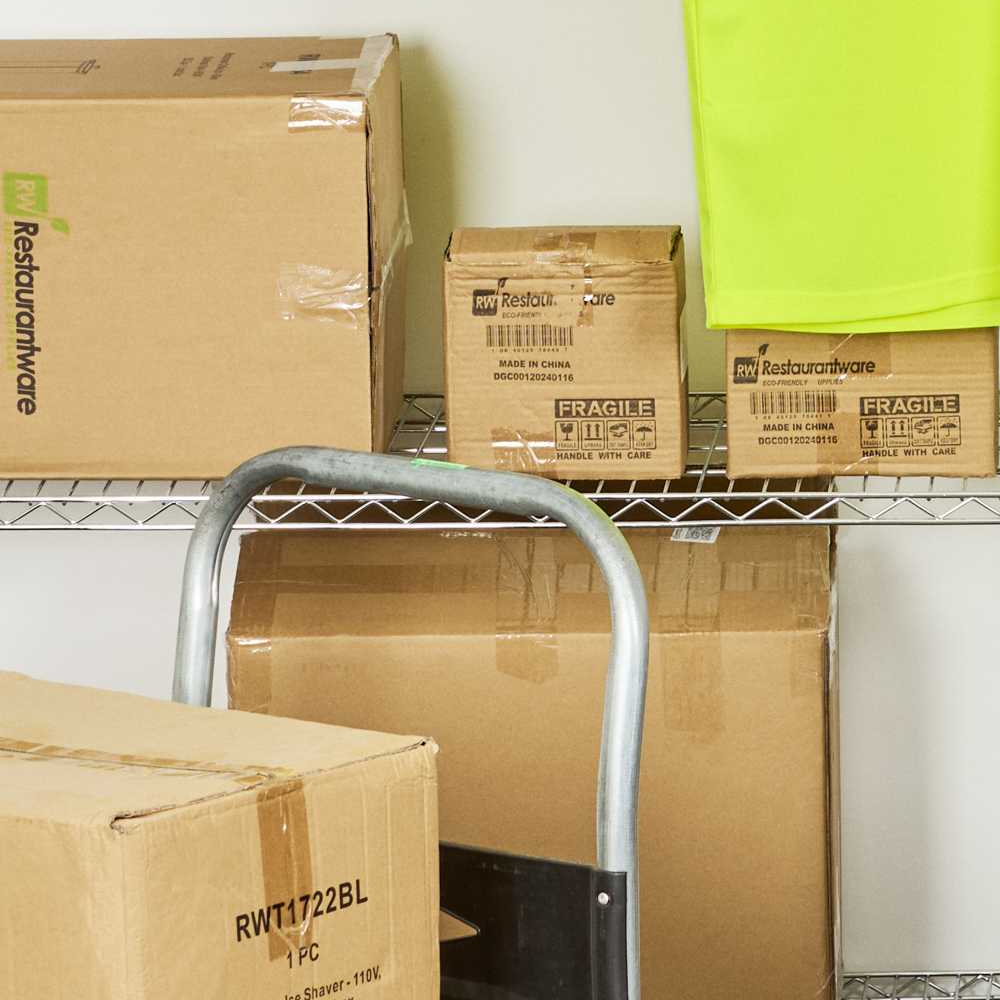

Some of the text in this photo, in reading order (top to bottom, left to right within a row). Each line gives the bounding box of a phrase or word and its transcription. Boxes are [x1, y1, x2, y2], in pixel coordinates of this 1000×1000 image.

[15, 178, 36, 216] RW
[475, 295, 496, 310] RW
[14, 220, 41, 416] Restaurantware
[498, 360, 571, 369] MADE IN CHINA
[736, 364, 756, 377] RW
[761, 358, 876, 375] Restaurantware
[493, 372, 574, 382] DGC00120240116
[559, 400, 652, 417] FRAGILE
[864, 396, 957, 415] FRAGILE
[762, 422, 835, 432] MADE IN CHINA
[758, 435, 838, 445] DGC00120240116
[556, 451, 652, 460] HANDLE WITH CARE
[862, 447, 957, 458] HANDLE WITH CARE
[235, 878, 368, 942] RWT1722BL
[287, 943, 320, 969] 1 PC
[303, 979, 344, 1000] Shaver
